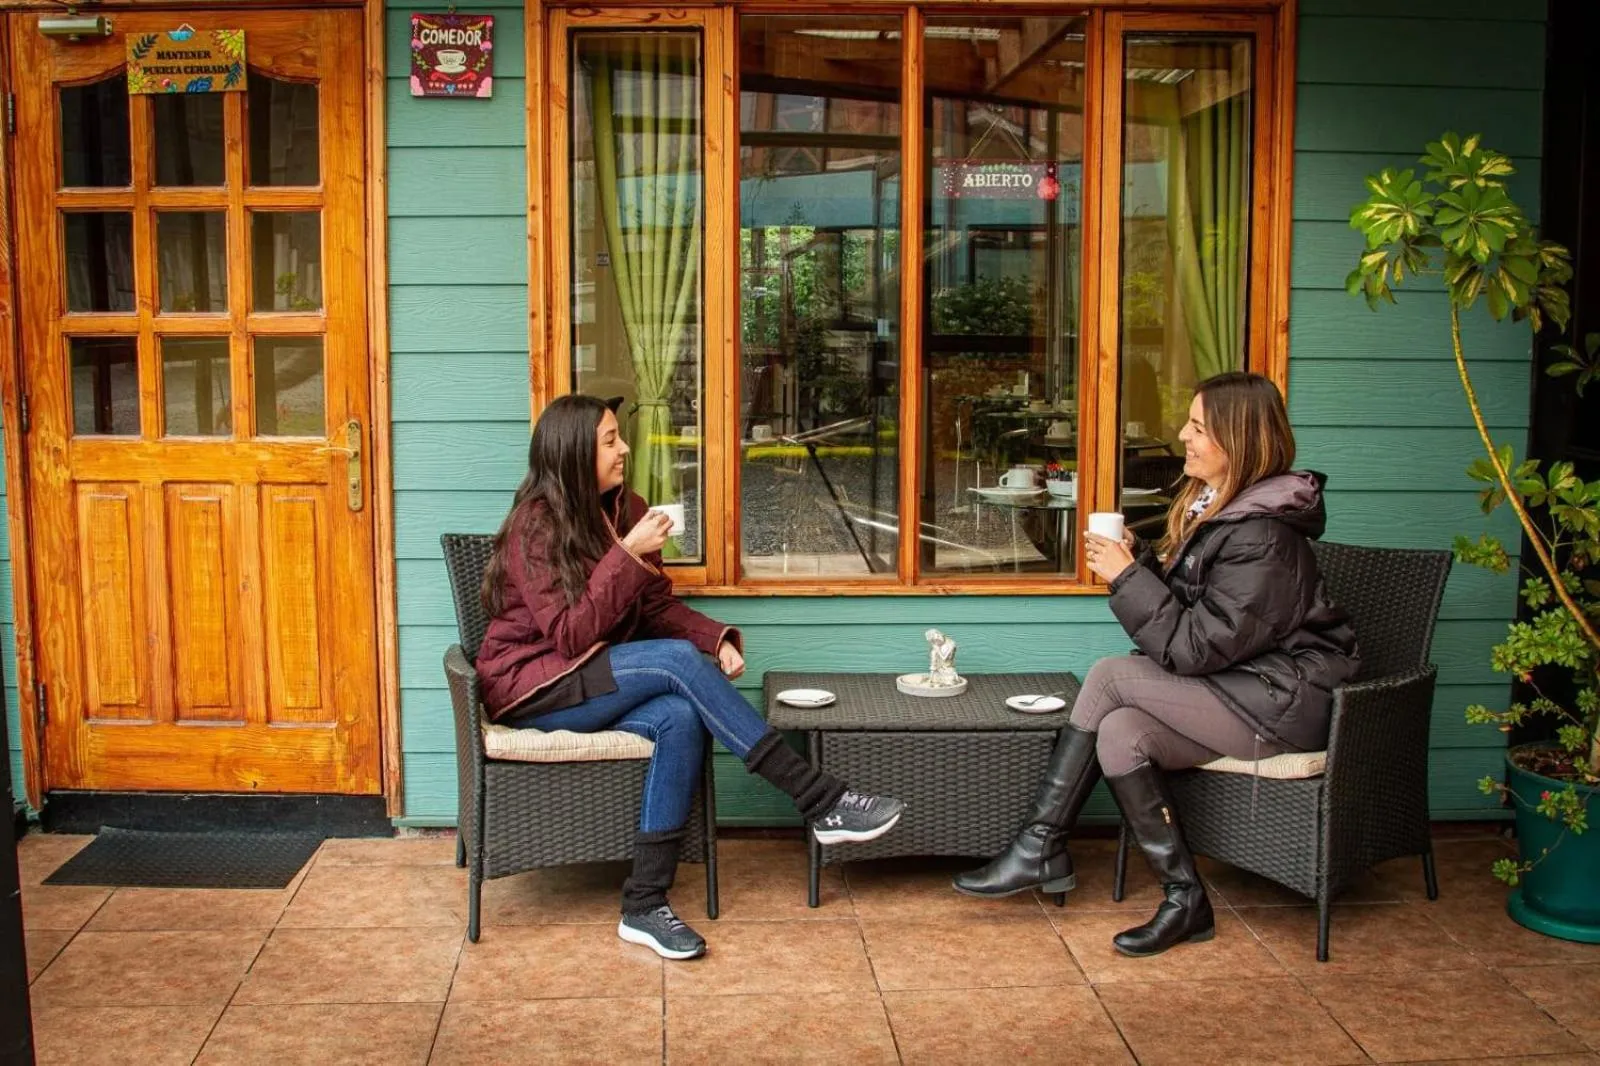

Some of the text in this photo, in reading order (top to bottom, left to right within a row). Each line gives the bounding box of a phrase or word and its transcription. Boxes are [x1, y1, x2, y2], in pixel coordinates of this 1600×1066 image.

[420, 28, 482, 46] COMEDOR
[157, 50, 211, 60] MANTENER
[184, 64, 230, 74] CERRADA
[963, 173, 1032, 187] ABIERTO
